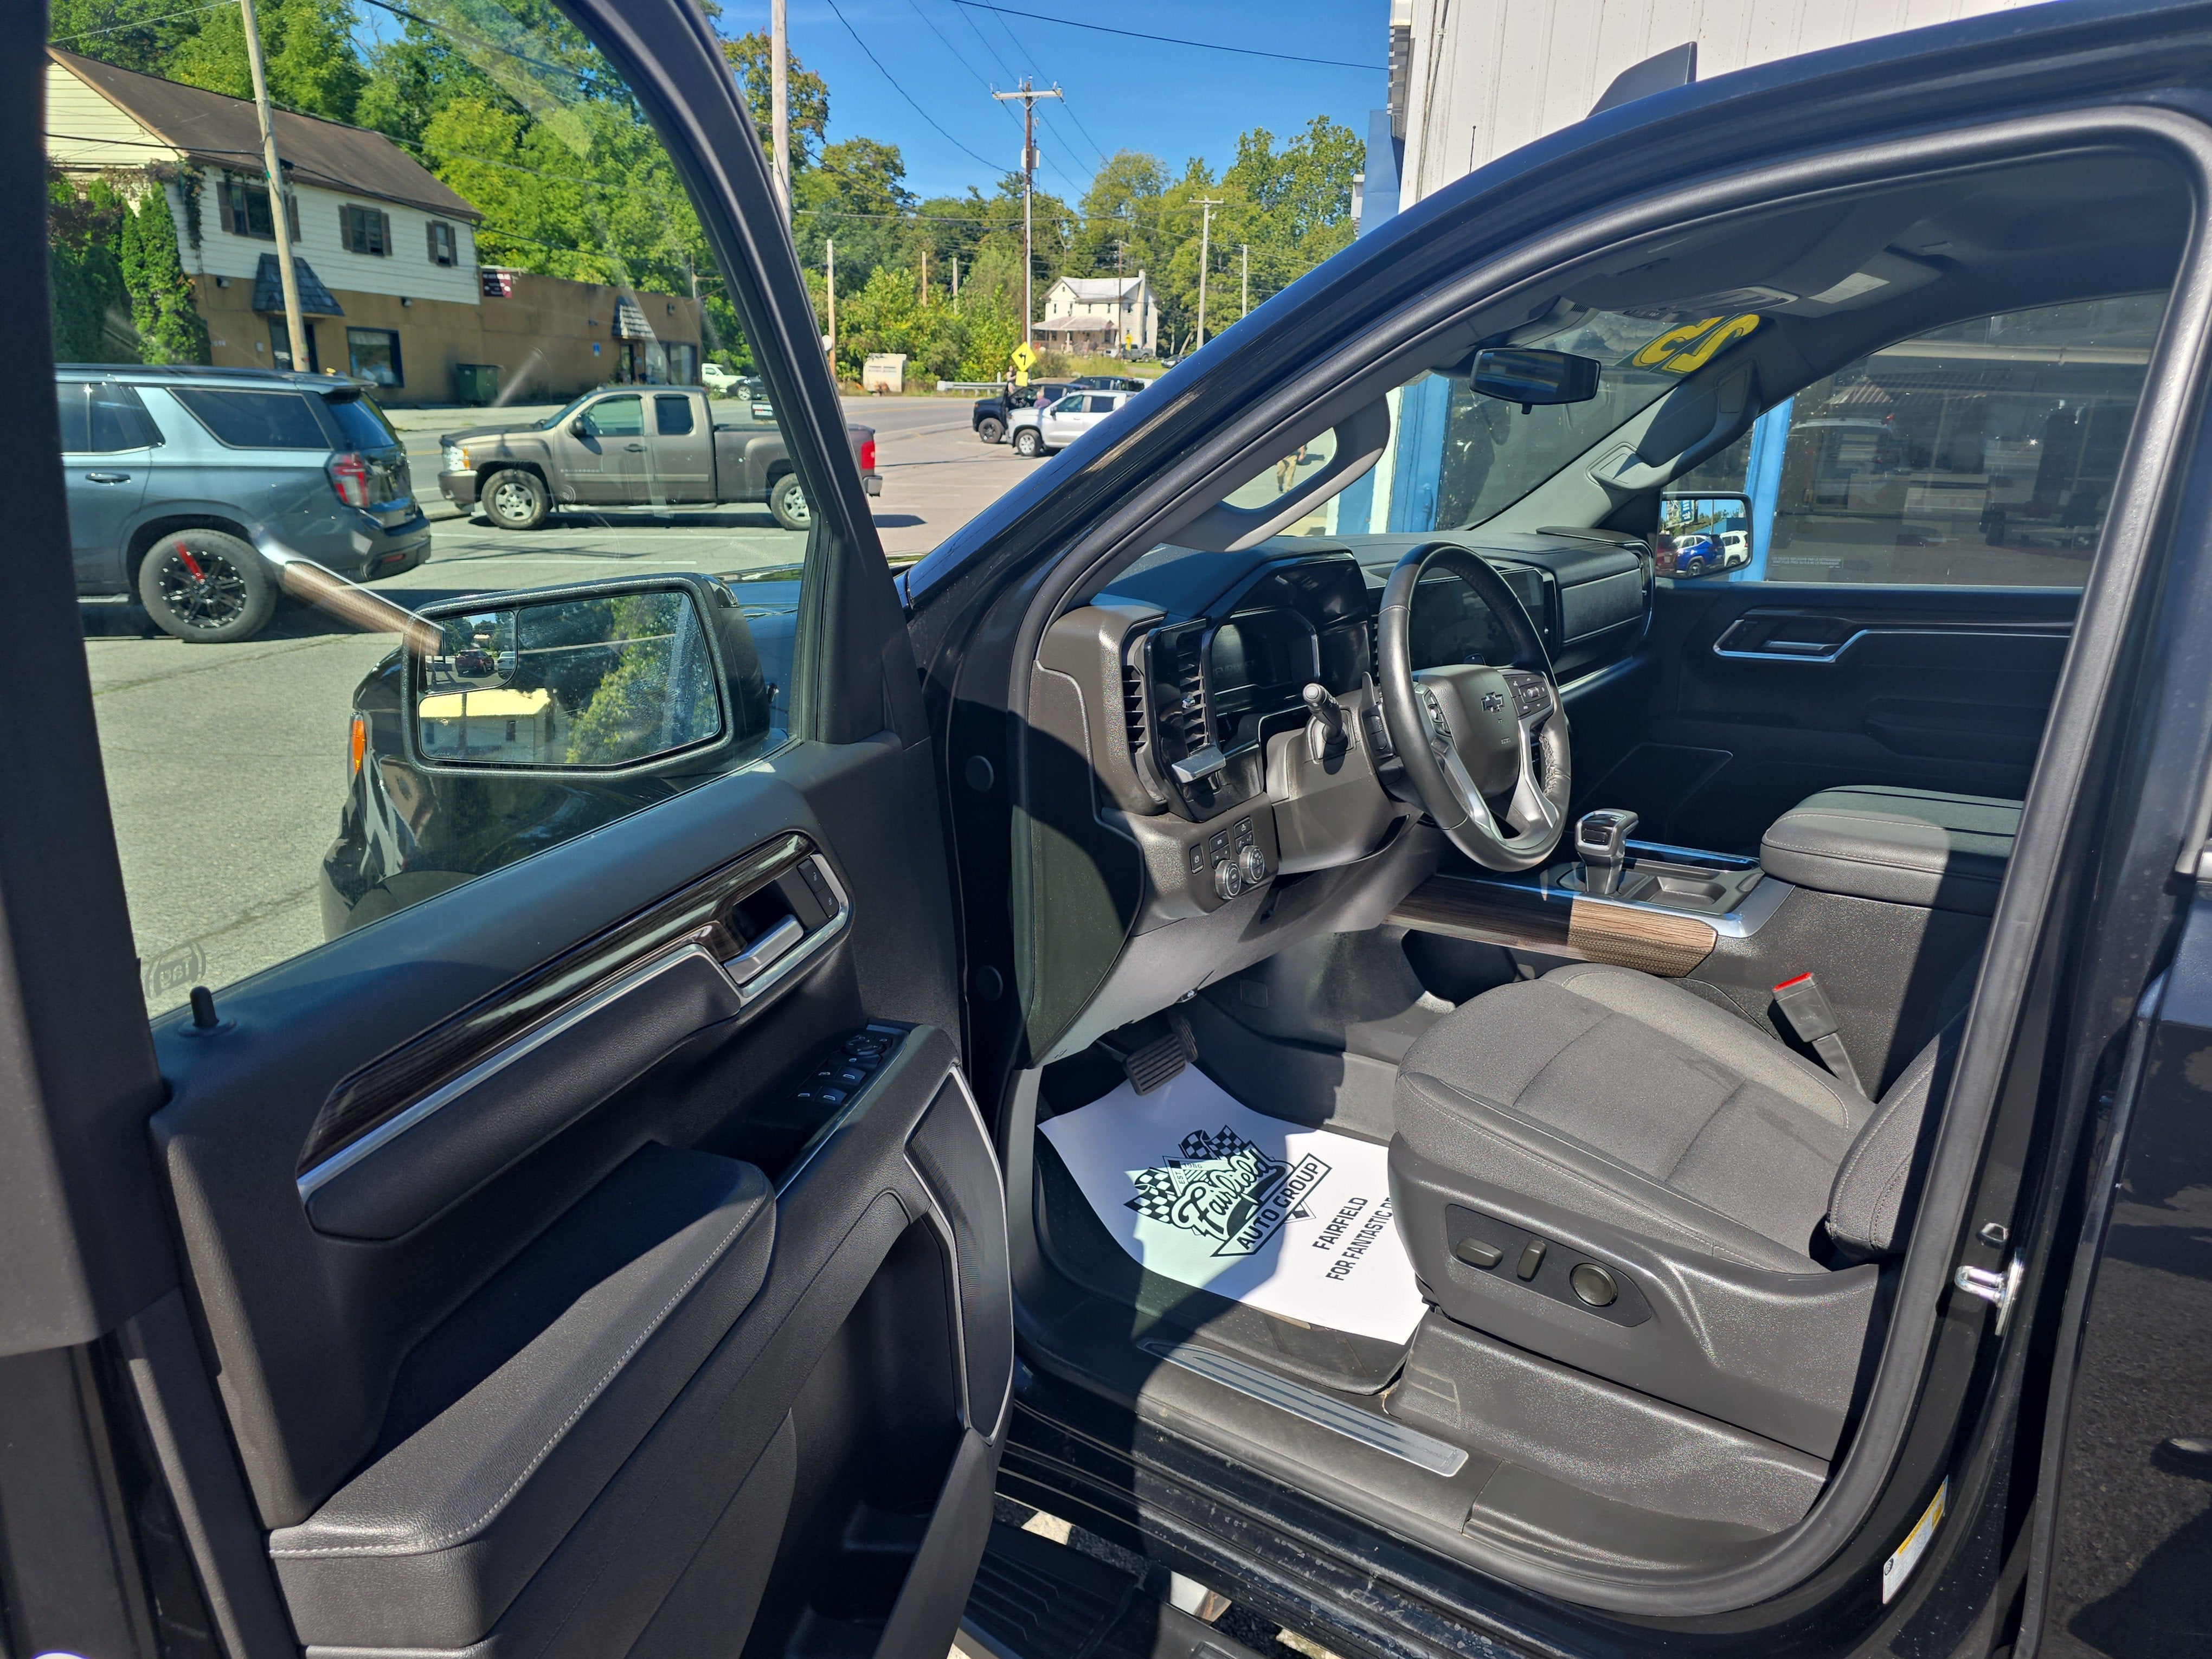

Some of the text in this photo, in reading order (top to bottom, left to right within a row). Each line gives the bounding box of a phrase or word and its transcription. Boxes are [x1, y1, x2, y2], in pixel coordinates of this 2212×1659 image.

[1176, 1147, 1272, 1236] Fairfield
[1236, 1162, 1319, 1250] AUTO GROUP
[1311, 1197, 1368, 1250] FAIRFIELD
[1325, 1259, 1356, 1281] FOR
[1341, 1210, 1393, 1259] FANTASTIC
